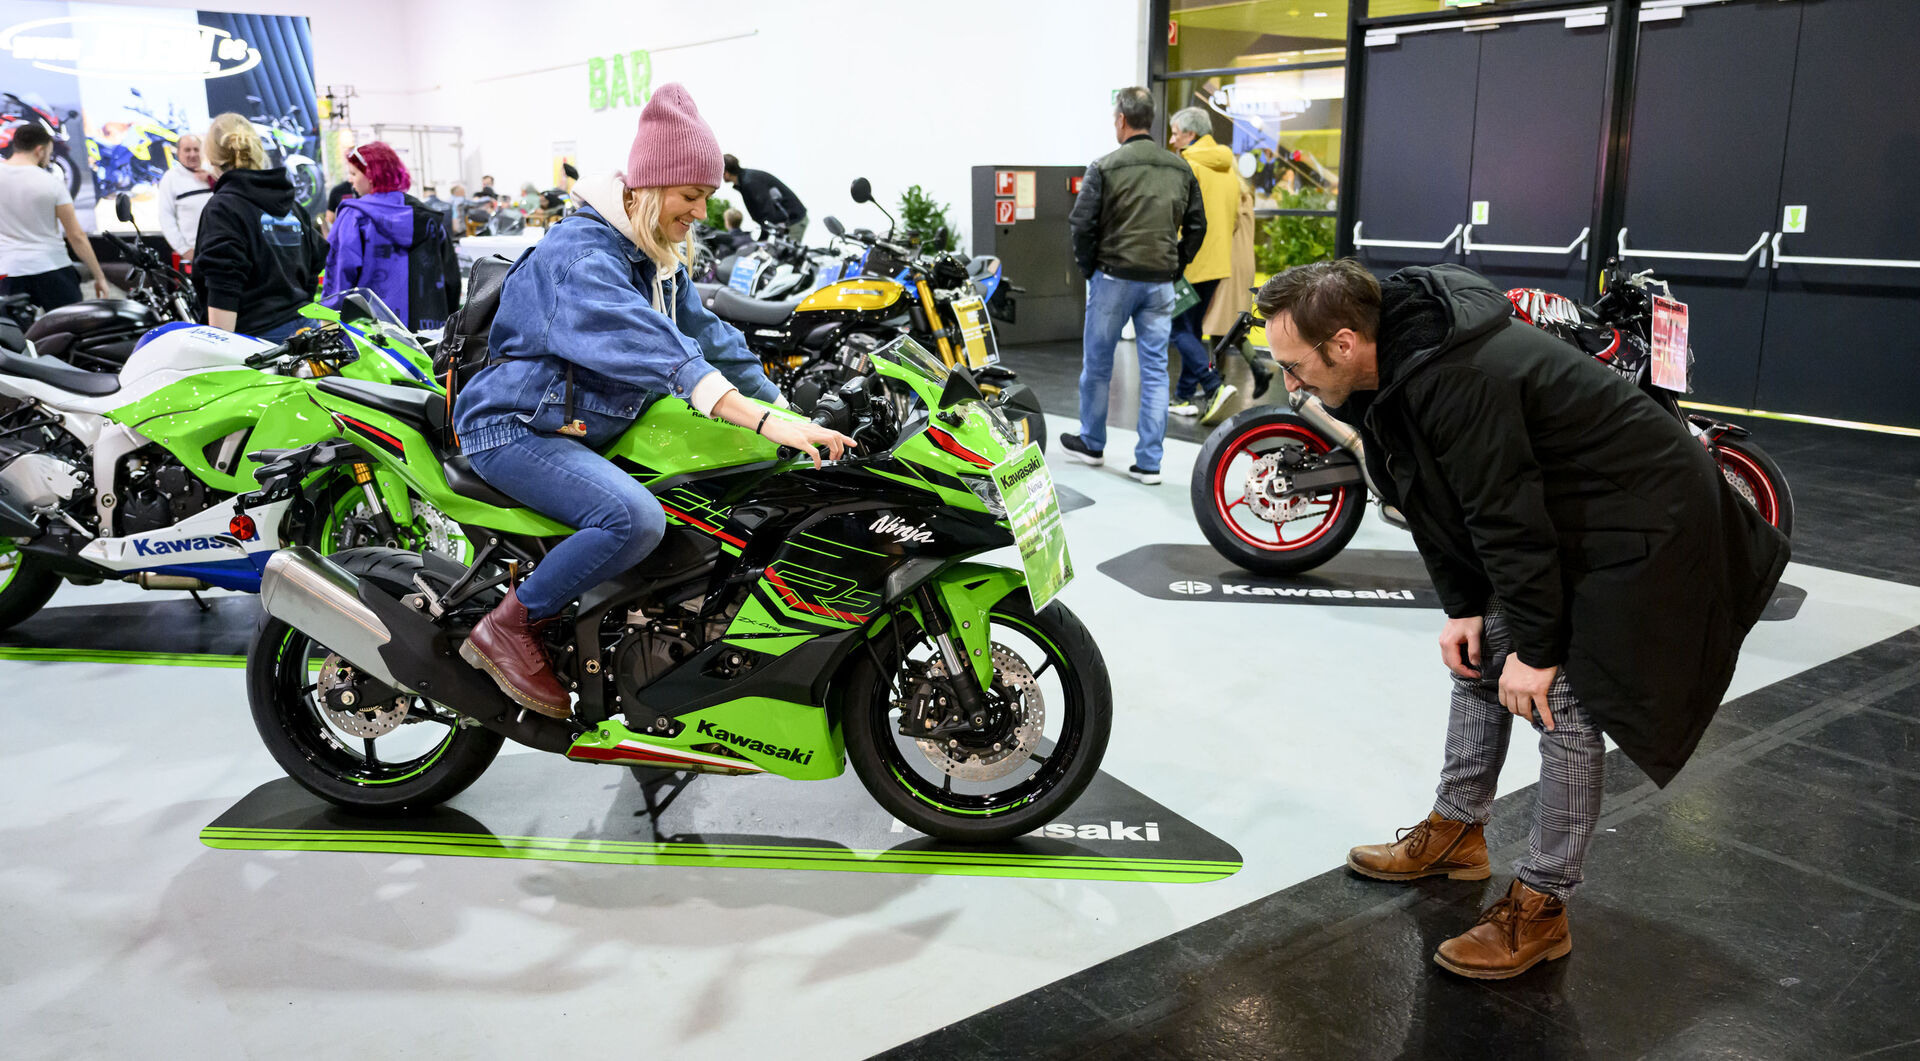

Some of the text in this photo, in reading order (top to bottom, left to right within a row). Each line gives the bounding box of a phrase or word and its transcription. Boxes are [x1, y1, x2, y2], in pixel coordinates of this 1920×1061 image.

[588, 49, 651, 108] BAR
[1000, 455, 1041, 490] Kawasaki
[869, 515, 935, 543] Ninja
[1222, 584, 1415, 600] Kawasaki
[697, 719, 814, 765] Kawasaki
